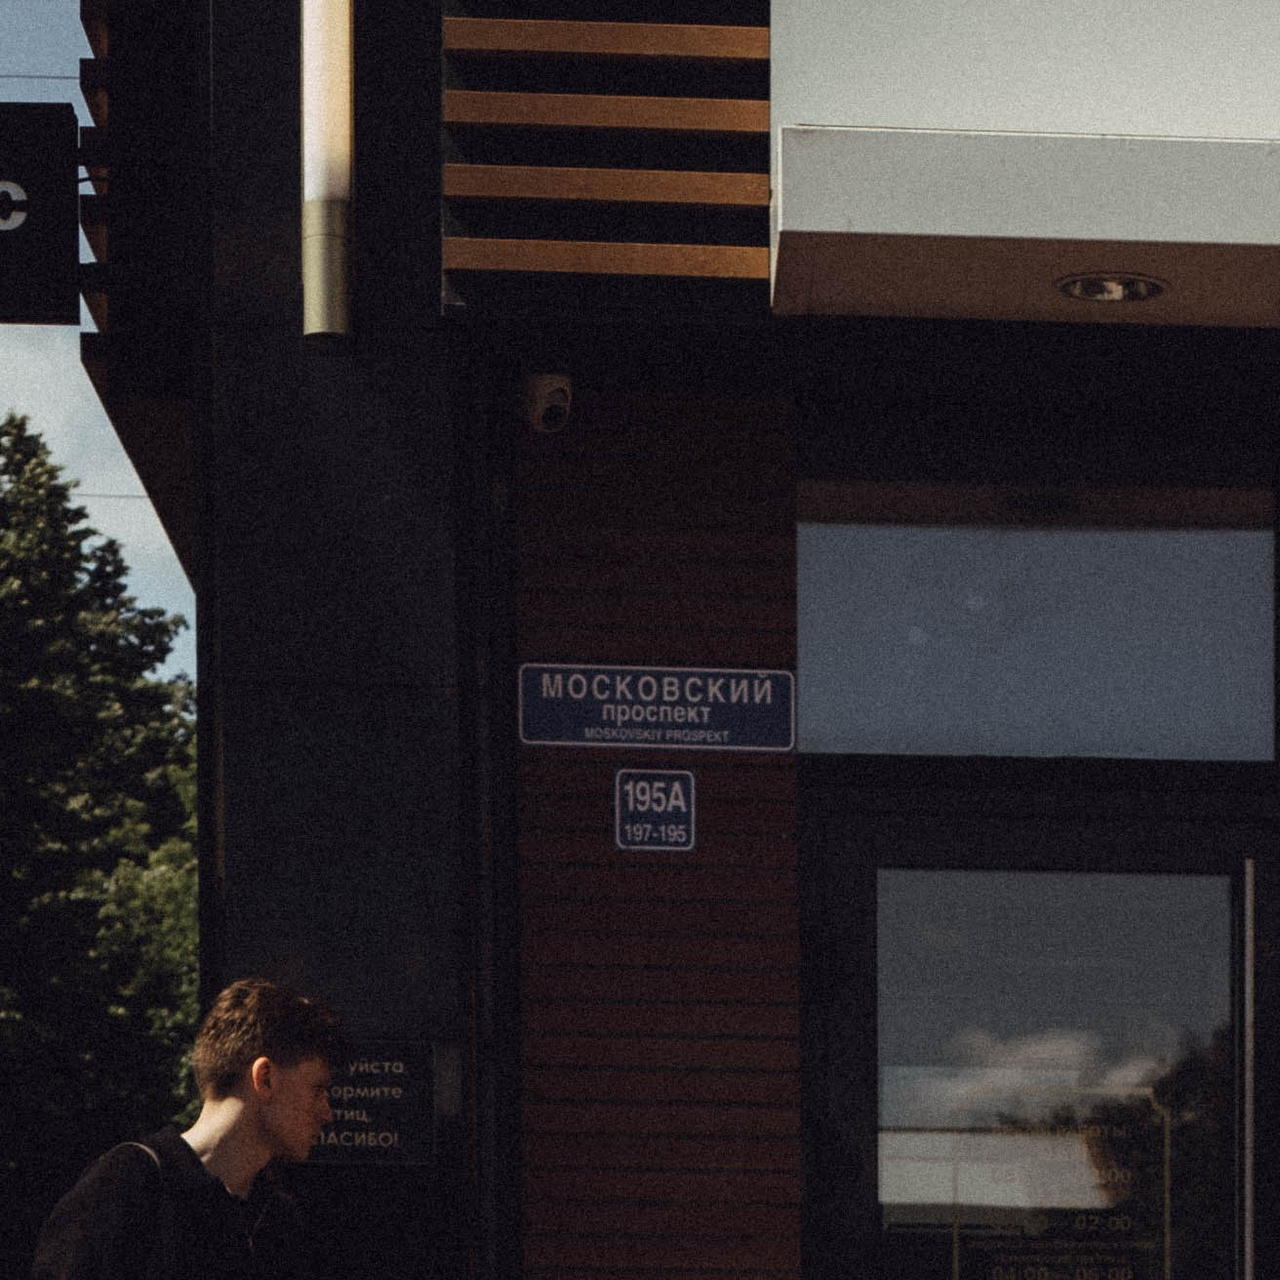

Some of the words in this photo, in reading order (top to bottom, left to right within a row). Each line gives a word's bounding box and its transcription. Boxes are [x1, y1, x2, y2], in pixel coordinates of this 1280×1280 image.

[541, 671, 773, 704] МОСКОВСКИЙ
[602, 704, 711, 726] проспект
[666, 729, 729, 743] PROSPEKT
[624, 780, 687, 813] 195А
[624, 824, 687, 843] 197-195
[349, 1058, 403, 1076] уйста
[329, 1085, 403, 1101] ормите
